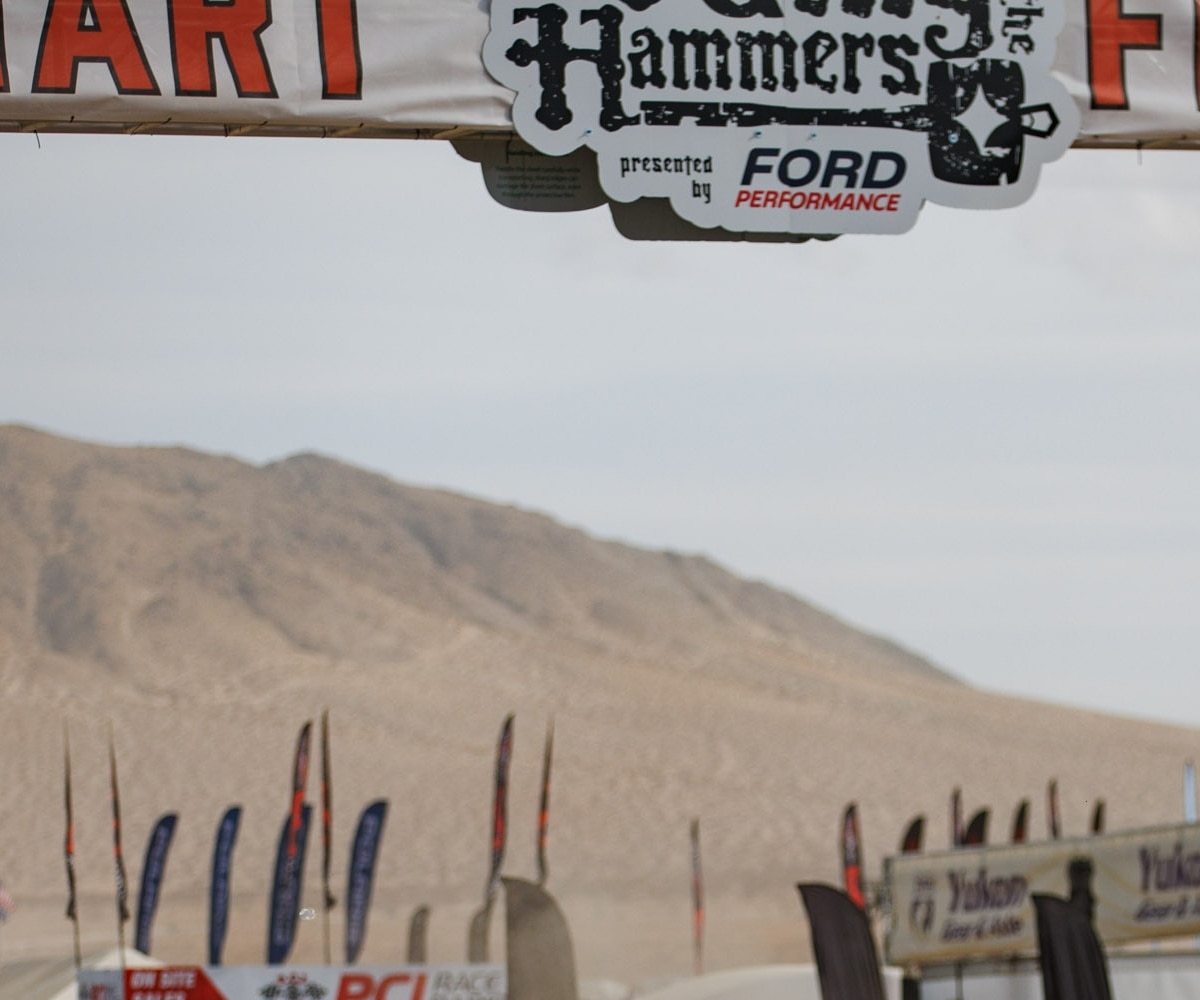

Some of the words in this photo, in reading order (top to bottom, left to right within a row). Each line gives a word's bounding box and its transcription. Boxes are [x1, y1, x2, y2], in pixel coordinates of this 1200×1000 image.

[0, 0, 362, 100] ART
[506, 2, 920, 130] Hammers
[620, 155, 712, 178] presented
[740, 147, 907, 189] FORD
[692, 180, 711, 203] by
[734, 190, 902, 211] PERFORMANCE
[131, 971, 157, 988] ON
[431, 970, 500, 992] RACE
